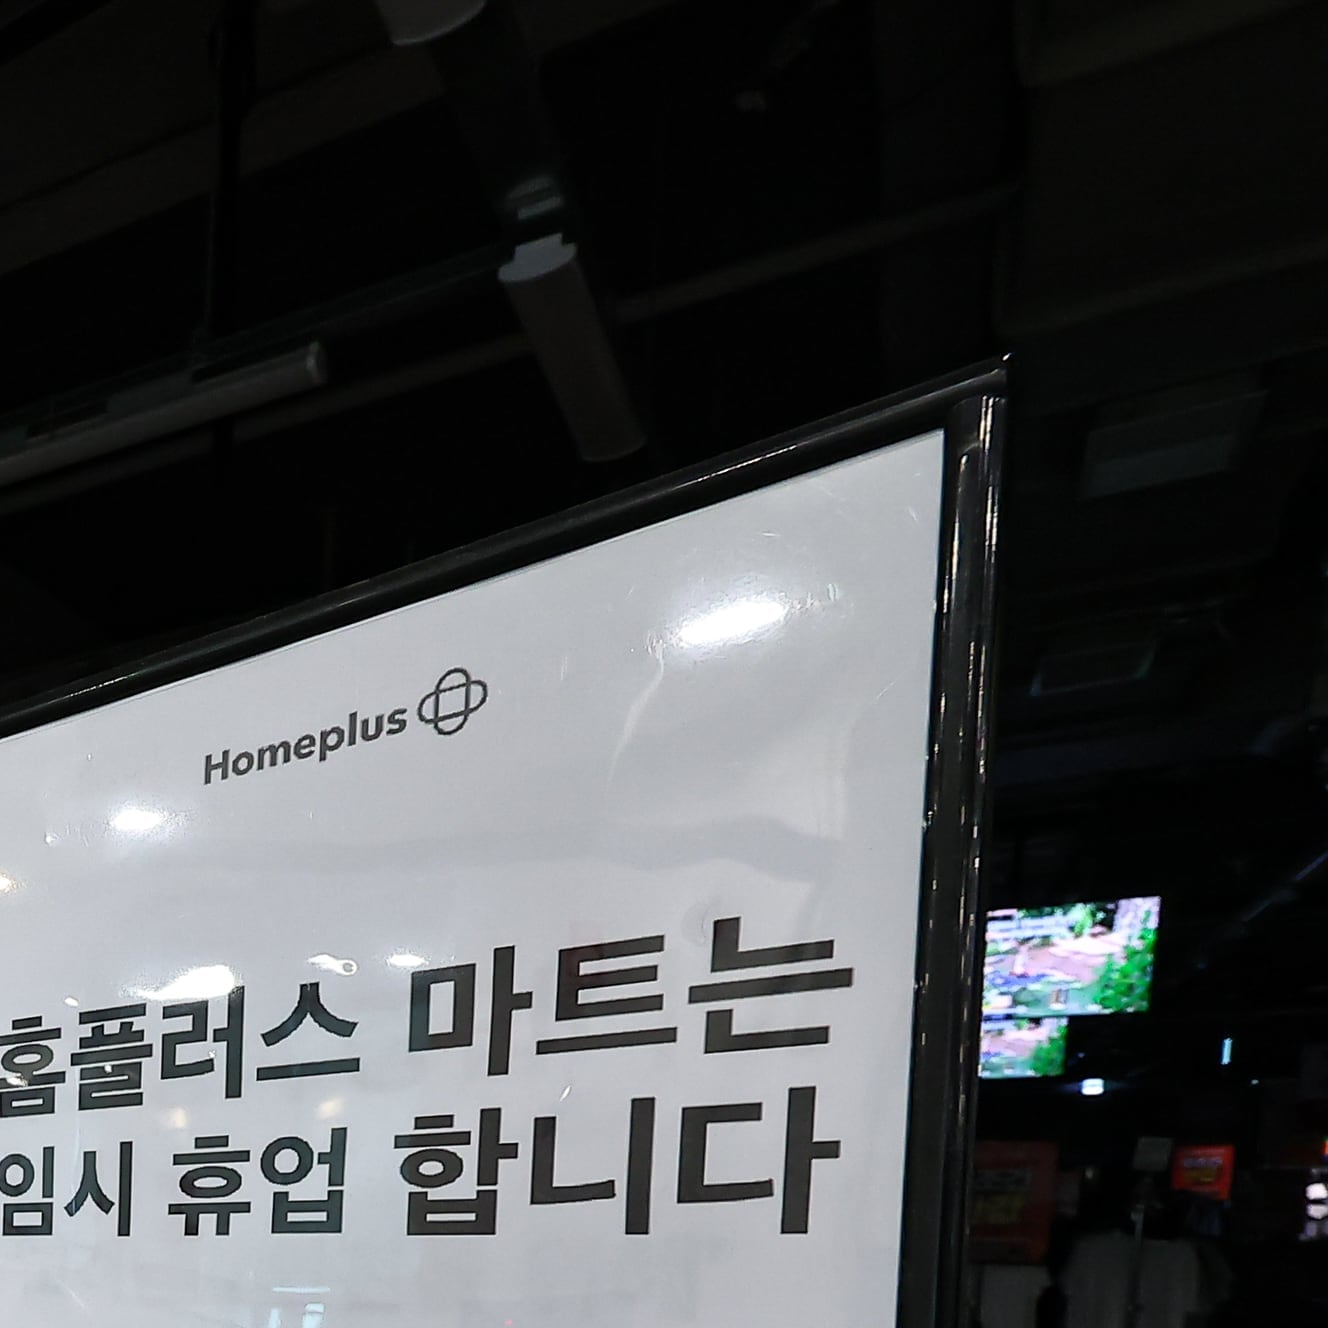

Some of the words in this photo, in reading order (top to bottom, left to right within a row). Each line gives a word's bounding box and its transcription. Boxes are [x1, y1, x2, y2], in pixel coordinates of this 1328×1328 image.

[201, 699, 408, 786] Homeplus
[407, 916, 855, 1077] 마트는
[166, 1127, 345, 1237] 휴업
[393, 1086, 842, 1236] 합니다
